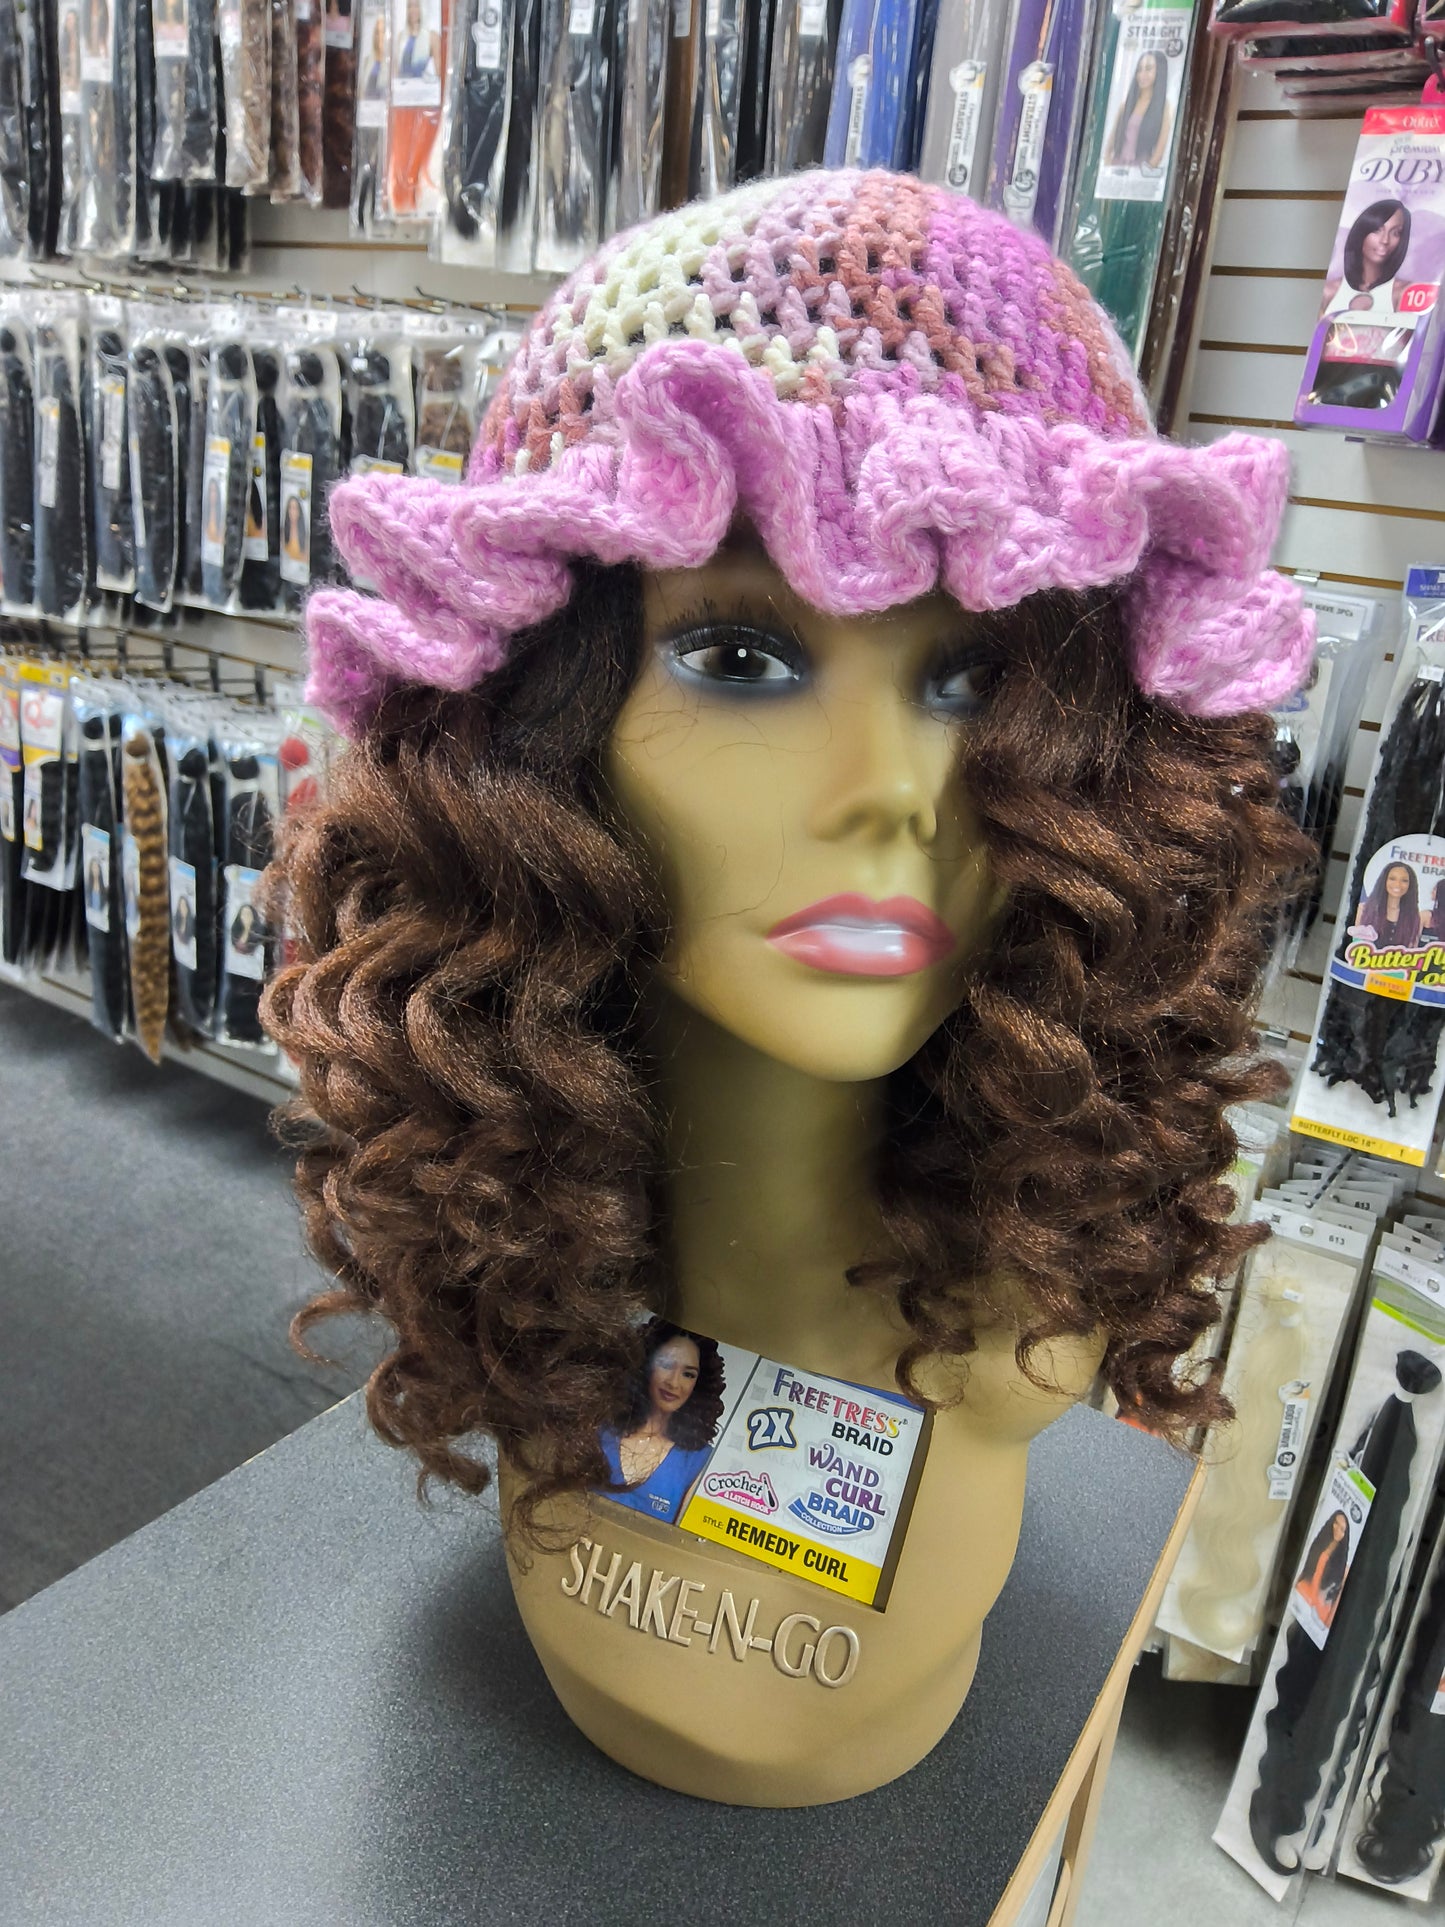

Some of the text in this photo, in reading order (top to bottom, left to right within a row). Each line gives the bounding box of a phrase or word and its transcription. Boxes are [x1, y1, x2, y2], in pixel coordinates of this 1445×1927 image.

[1127, 26, 1184, 38] STRAGHT
[954, 92, 968, 141] STRAIGHT
[1021, 94, 1037, 143] STRAIGHT
[1298, 1121, 1340, 1138] BUTTERFLY
[1343, 1134, 1358, 1144] LOC
[1328, 1235, 1345, 1246] 613
[749, 1408, 796, 1449] 2X
[831, 1421, 893, 1456] BRAID
[809, 1444, 880, 1488] WAND
[708, 1476, 763, 1497] Crochet
[730, 1493, 750, 1508] LATCH
[751, 1500, 769, 1514] HOOK
[826, 1477, 886, 1516] CURL
[801, 1512, 843, 1533] COLLECTION
[808, 1492, 875, 1531] BRAID
[703, 1515, 849, 1583] STYLE: REMEDY CURL
[560, 1536, 860, 1689] SHAKE-N-GO
